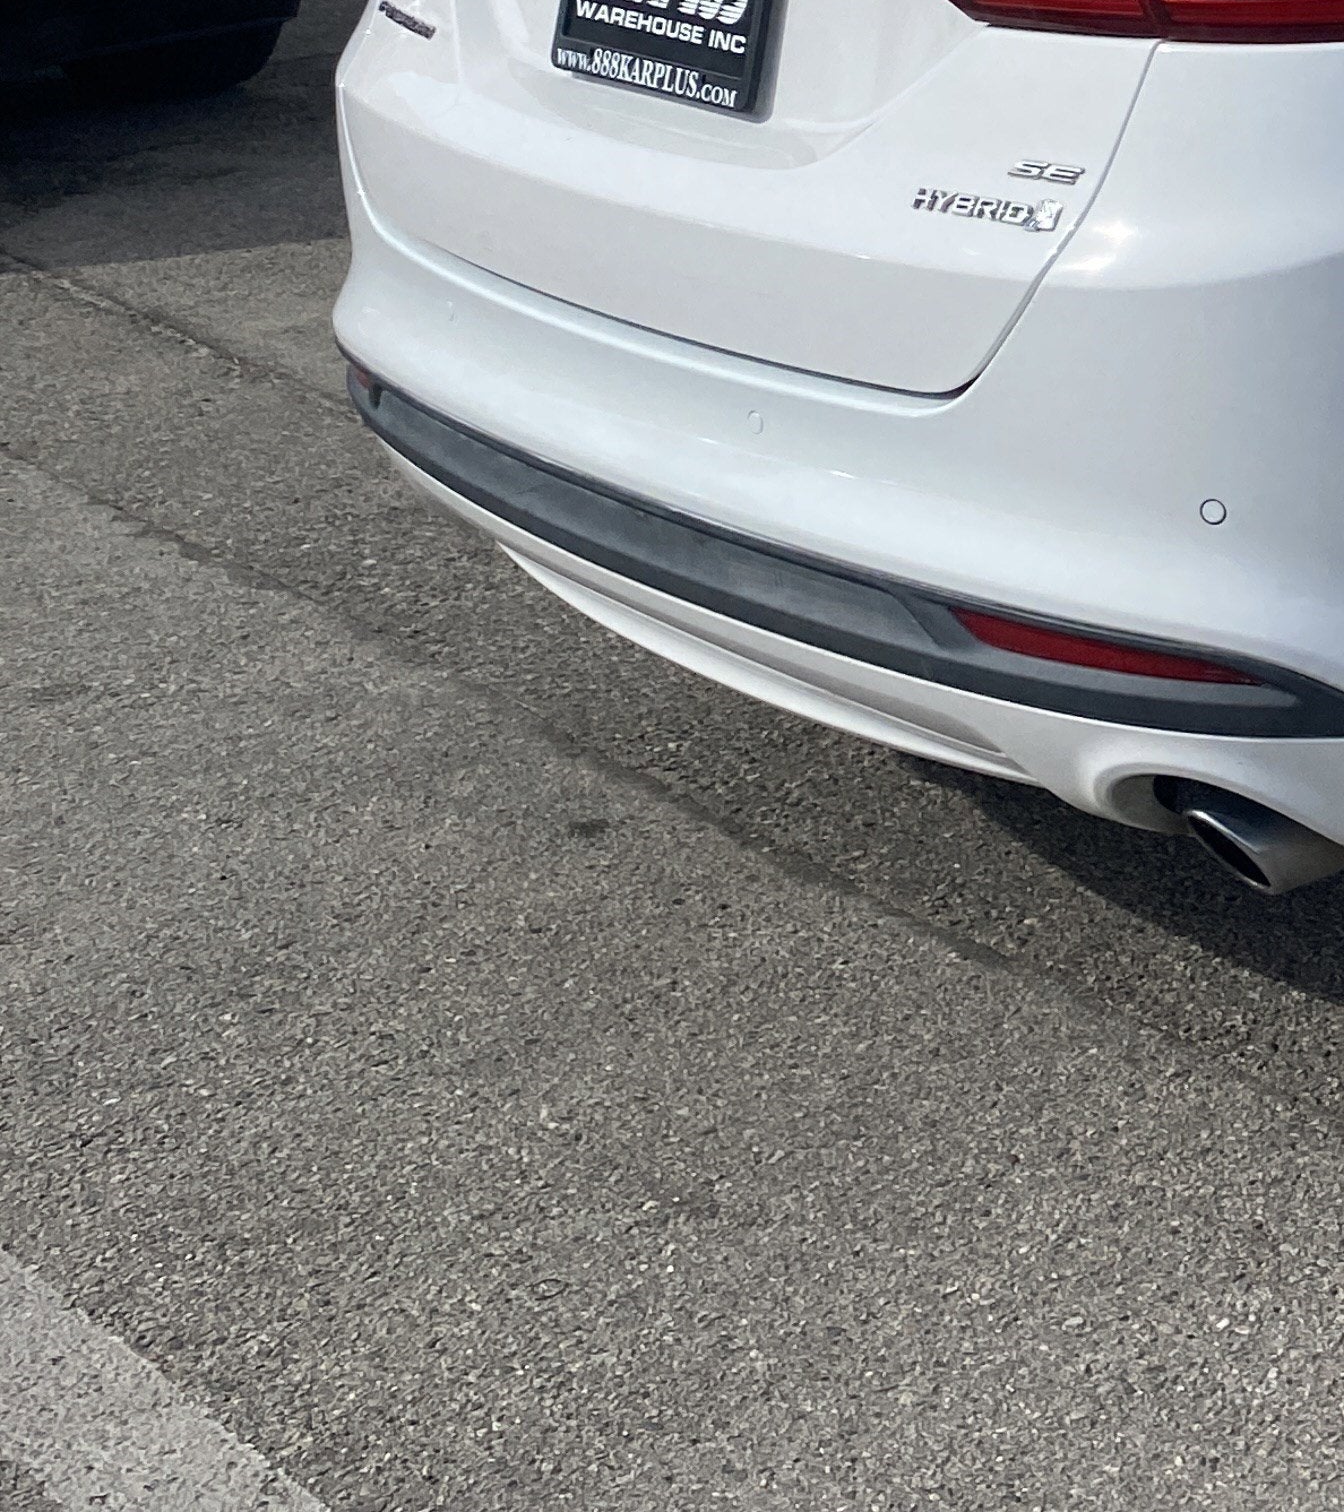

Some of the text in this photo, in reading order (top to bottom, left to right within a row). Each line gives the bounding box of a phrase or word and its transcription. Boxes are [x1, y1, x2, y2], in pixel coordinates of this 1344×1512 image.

[576, 0, 747, 54] WAREHOUSE INC
[1007, 159, 1086, 185] SE
[911, 187, 1035, 227] HYBRID
